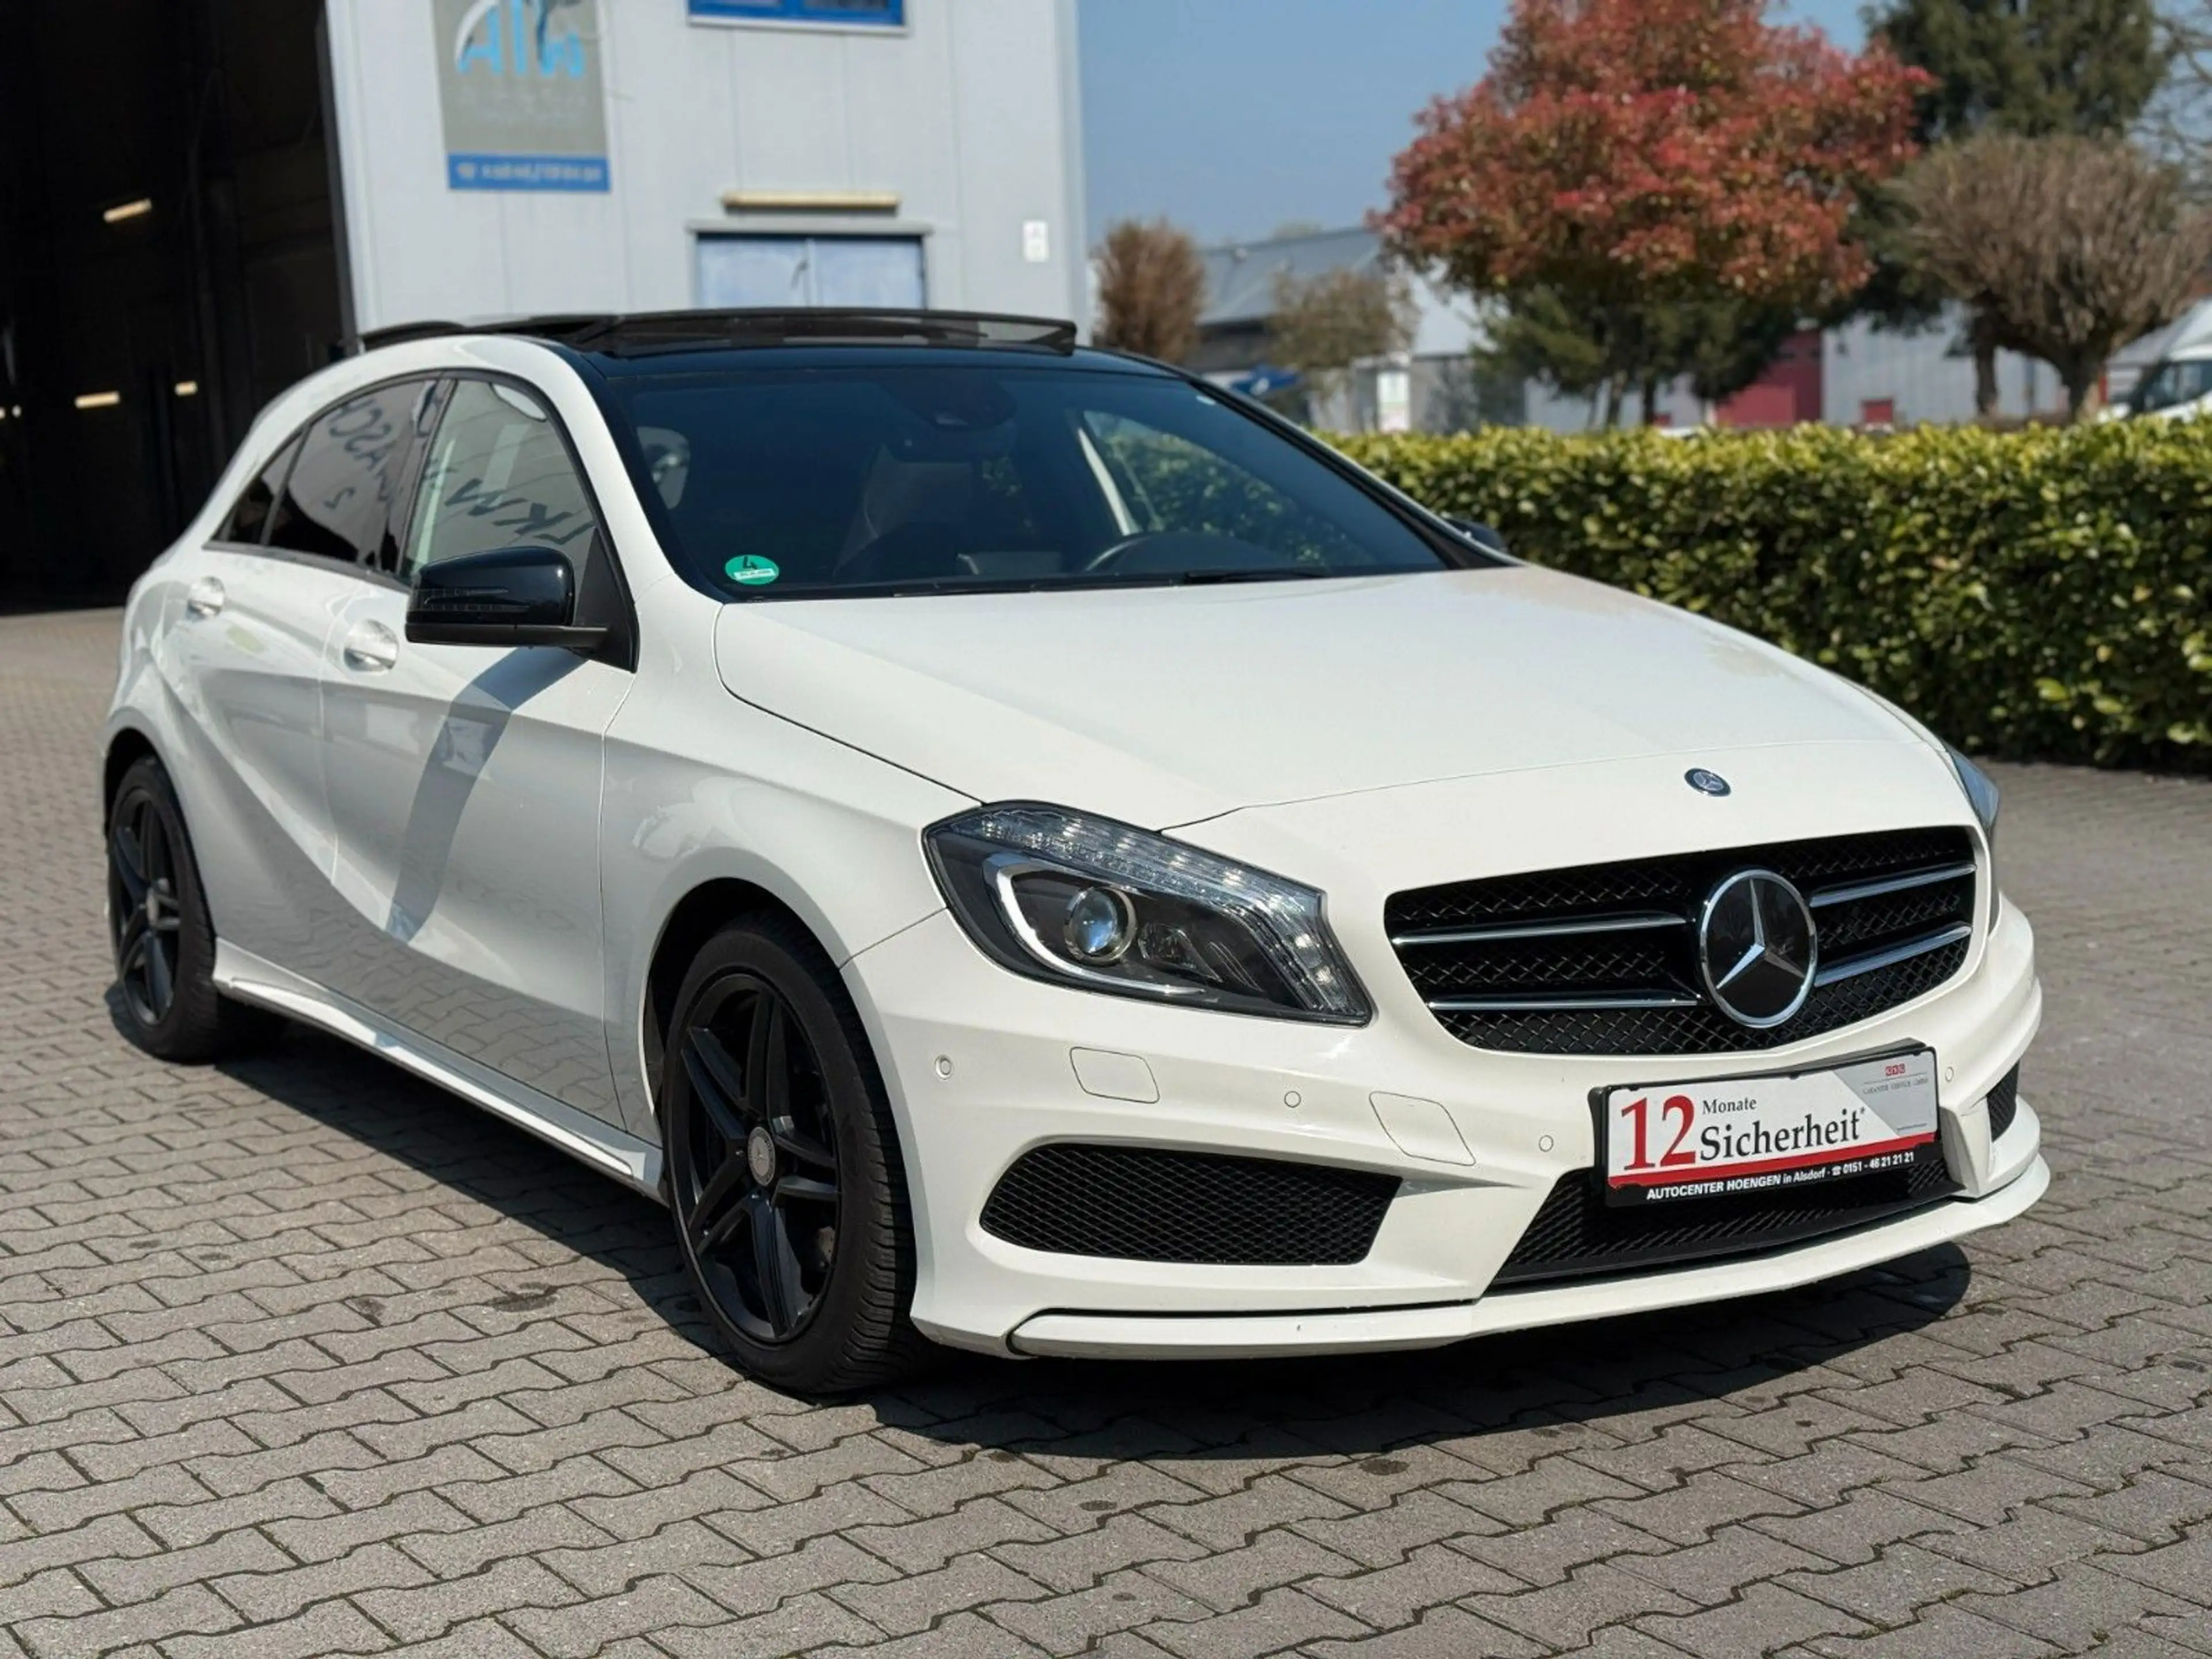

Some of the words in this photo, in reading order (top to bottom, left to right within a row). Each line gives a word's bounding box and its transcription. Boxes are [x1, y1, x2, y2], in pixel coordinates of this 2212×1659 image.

[742, 555, 758, 570] 4
[1621, 1094, 1696, 1171] 12
[1702, 1097, 1757, 1115] Monate
[1646, 1181, 1724, 1200] AUTOCENTER
[1726, 1174, 1781, 1191] HOENGEN
[1783, 1173, 1791, 1183] in
[1793, 1167, 1825, 1182] Alsdorf
[1843, 1161, 1862, 1174] 0151
[1881, 1156, 1891, 1167] 21
[1892, 1154, 1902, 1165] 21
[1904, 1152, 1914, 1162] 21
